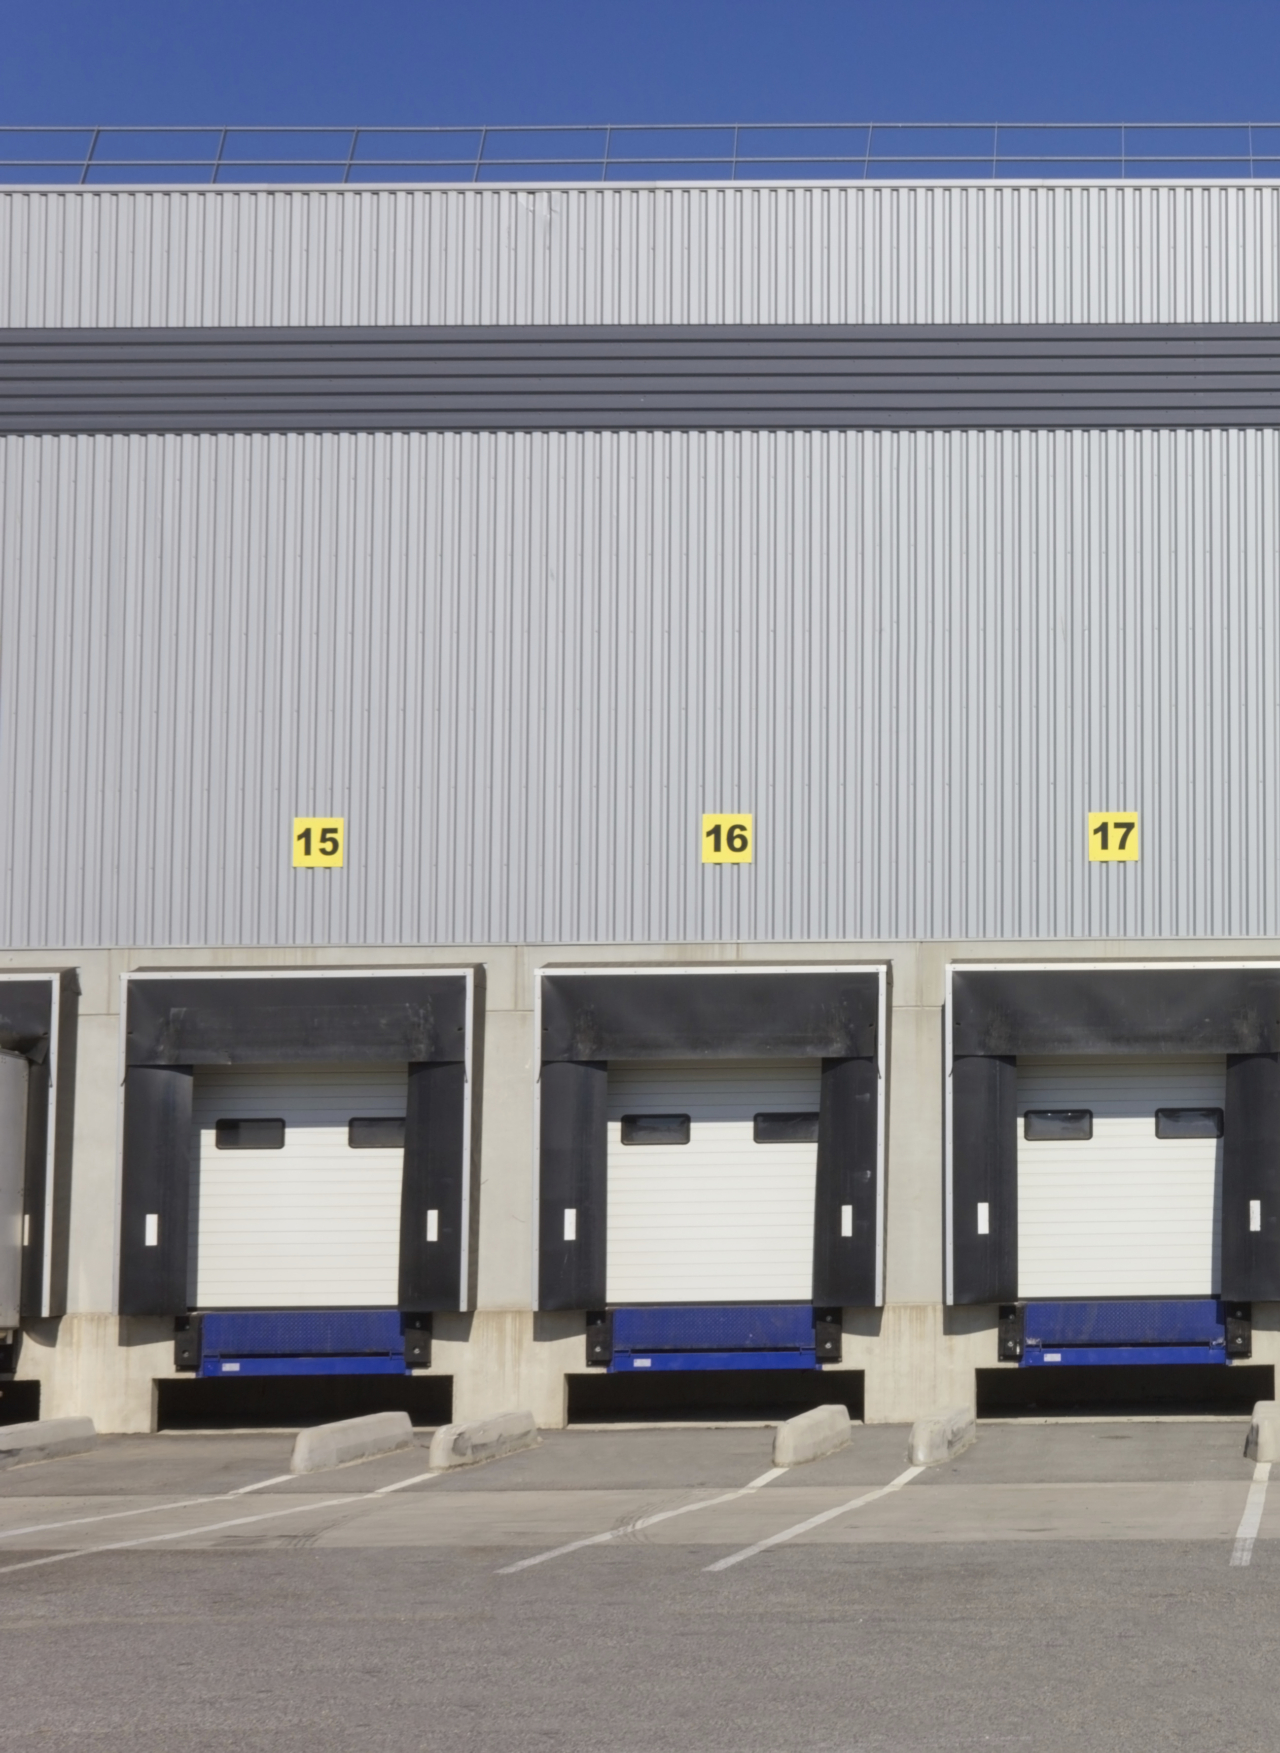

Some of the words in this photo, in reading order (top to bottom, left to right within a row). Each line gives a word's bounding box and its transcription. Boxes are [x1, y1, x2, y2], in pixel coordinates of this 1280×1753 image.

[298, 827, 339, 856] 15
[706, 824, 747, 853] 16
[1093, 822, 1134, 850] 17
